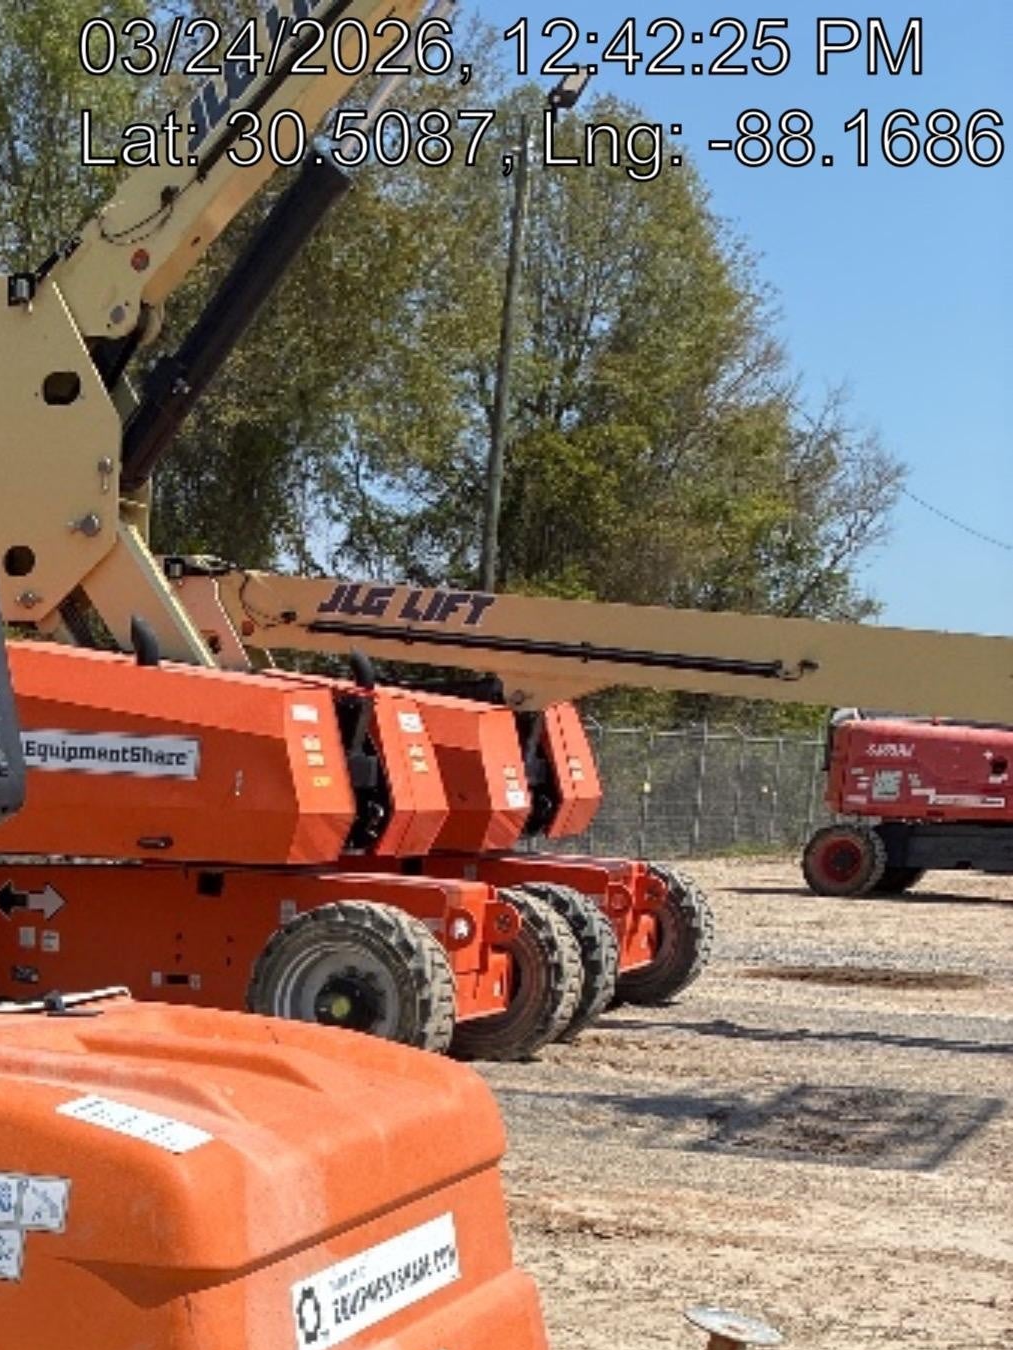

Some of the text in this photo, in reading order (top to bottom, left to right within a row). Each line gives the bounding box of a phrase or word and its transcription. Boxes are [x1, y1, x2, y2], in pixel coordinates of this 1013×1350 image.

[317, 584, 495, 625] JLG LIFT
[25, 740, 186, 766] EquipmentShare
